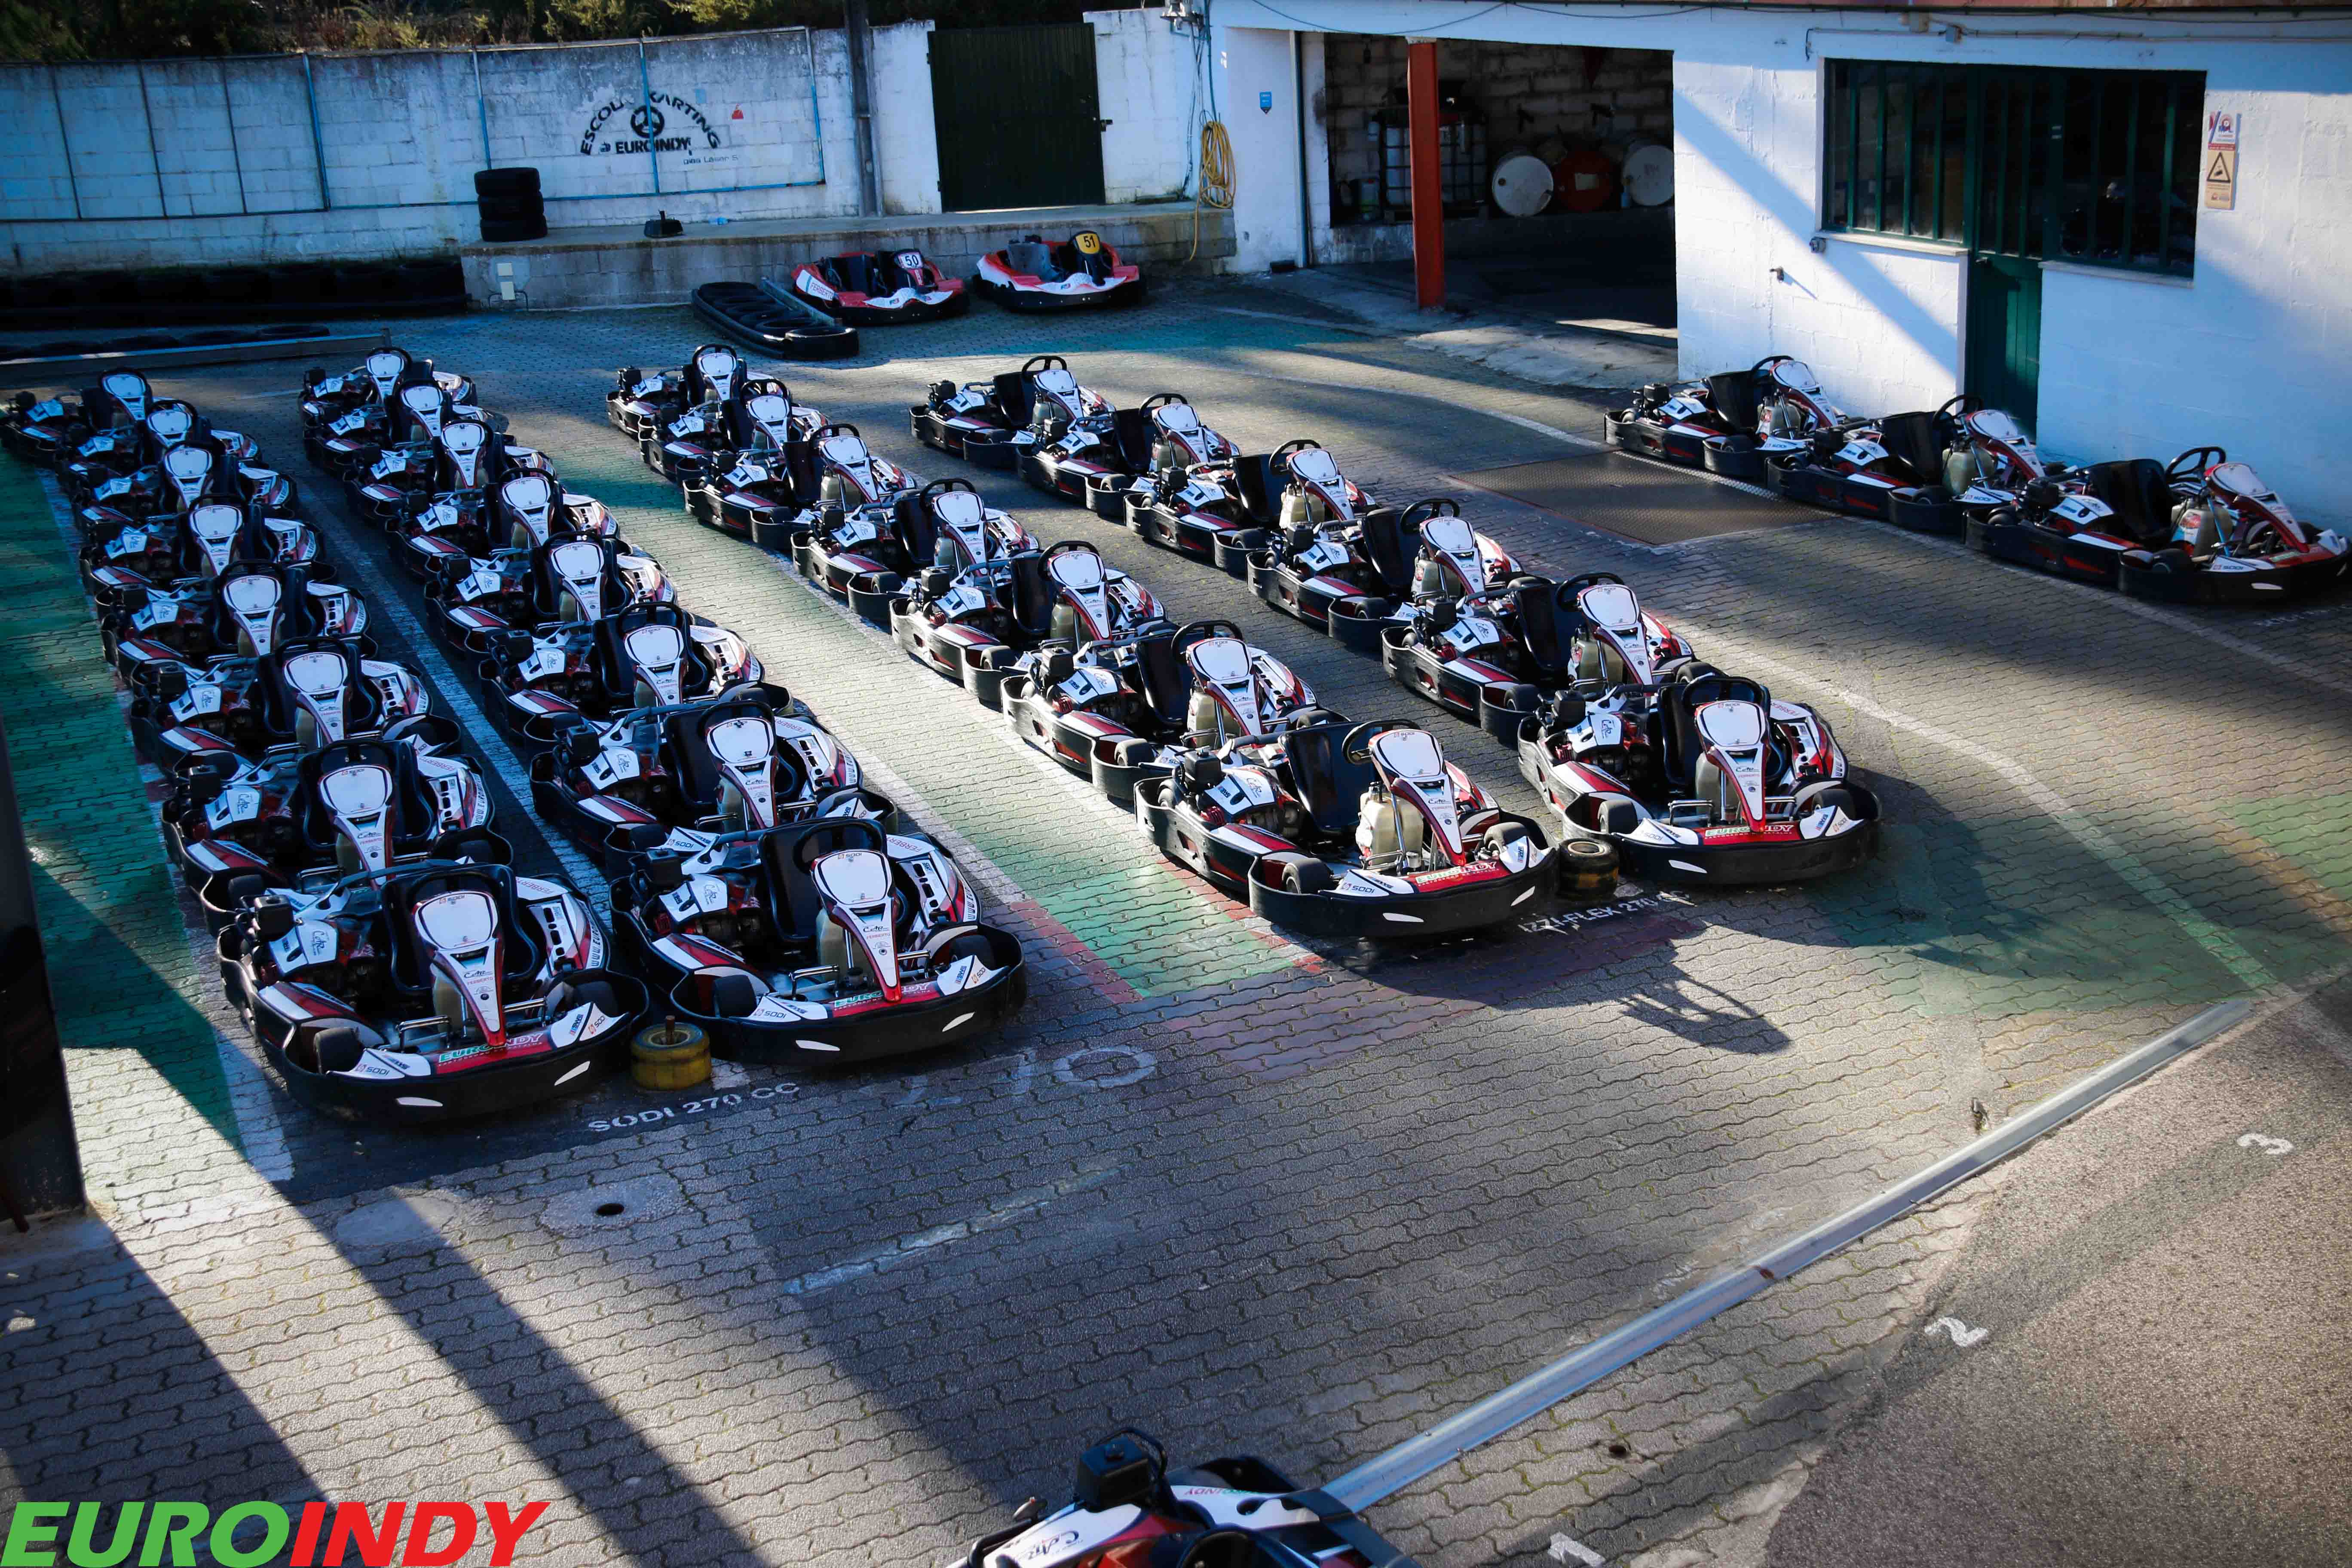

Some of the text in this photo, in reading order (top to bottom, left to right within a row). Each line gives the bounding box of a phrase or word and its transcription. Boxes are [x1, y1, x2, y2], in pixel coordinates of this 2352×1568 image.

[581, 97, 628, 155] ESCOL
[1084, 236, 1096, 248] 51
[905, 254, 919, 266] 50
[1643, 832, 1663, 841] SODI
[1705, 824, 1794, 837] EURODY
[1415, 861, 1497, 884] EUROINDY
[1351, 885, 1375, 894] SODI
[1617, 897, 1658, 913] 270
[834, 983, 930, 1008] EURODY
[763, 1010, 787, 1019] SODI
[439, 1033, 544, 1063] EURONDY
[366, 1066, 390, 1075] SODI
[588, 1082, 800, 1132] SODI 270 CC
[1924, 1316, 1989, 1348] 2
